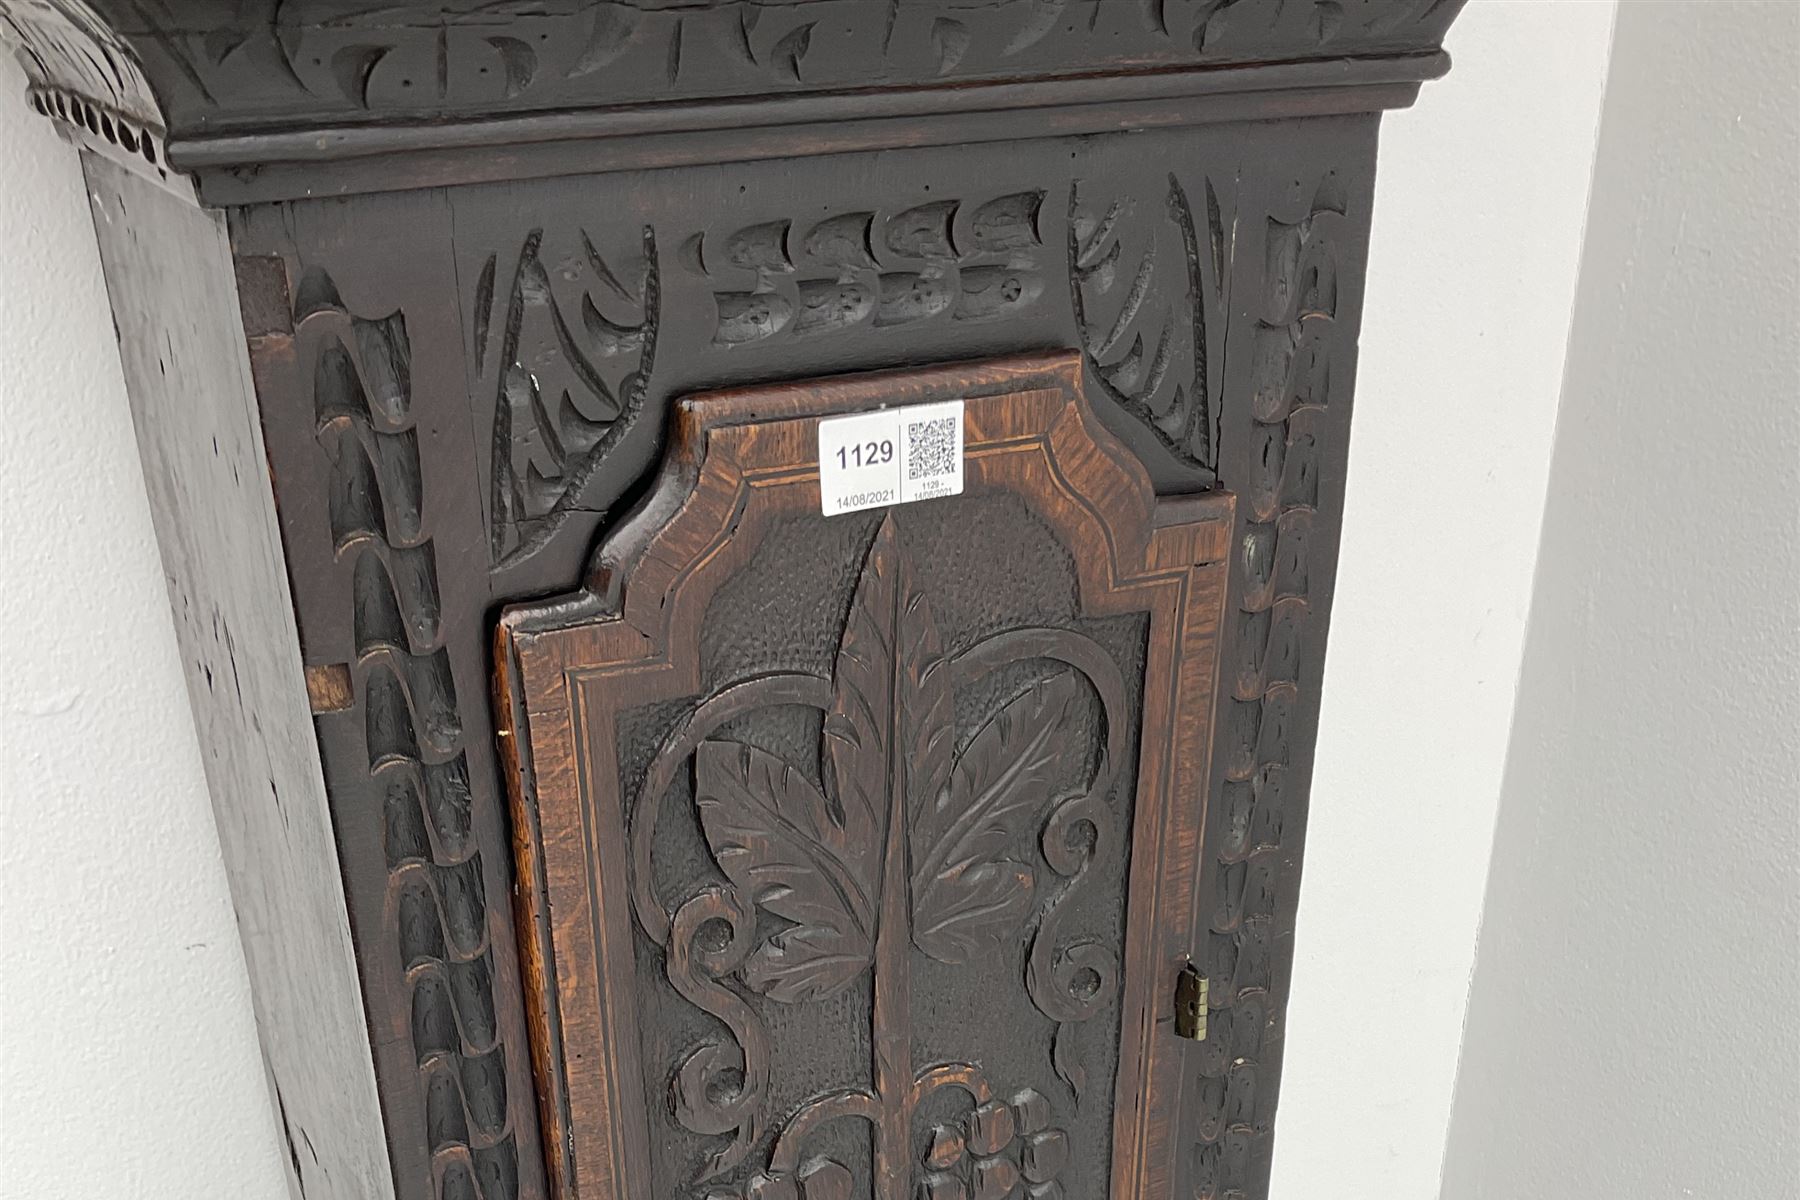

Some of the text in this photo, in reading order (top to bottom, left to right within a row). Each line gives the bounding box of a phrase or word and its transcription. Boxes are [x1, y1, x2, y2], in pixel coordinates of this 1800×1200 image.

[836, 440, 893, 470] 1129
[922, 481, 940, 490] 1129
[836, 489, 894, 509] 14/08/2021
